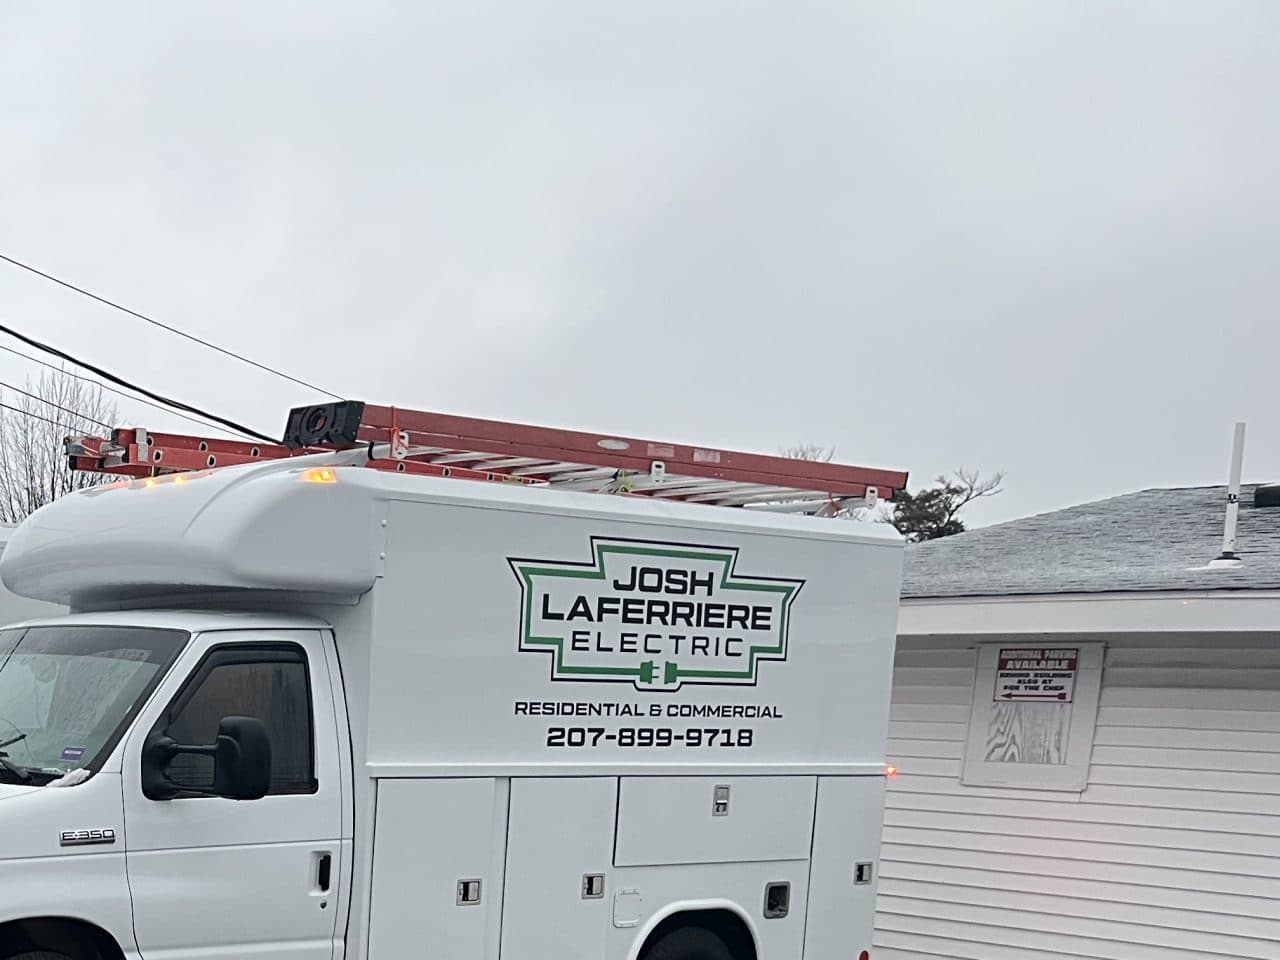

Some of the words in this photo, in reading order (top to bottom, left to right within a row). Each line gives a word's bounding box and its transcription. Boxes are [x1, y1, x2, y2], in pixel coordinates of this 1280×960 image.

[613, 566, 713, 596] JOSH
[541, 593, 773, 631] LAFERRIERE
[572, 631, 744, 657] ELECTRIC
[1006, 660, 1069, 669] AVAILABLE
[514, 701, 645, 717] RESIDENTIAL
[649, 703, 662, 717] &
[666, 704, 783, 718] COMMERCIAL
[546, 727, 754, 747] 207-899-9718
